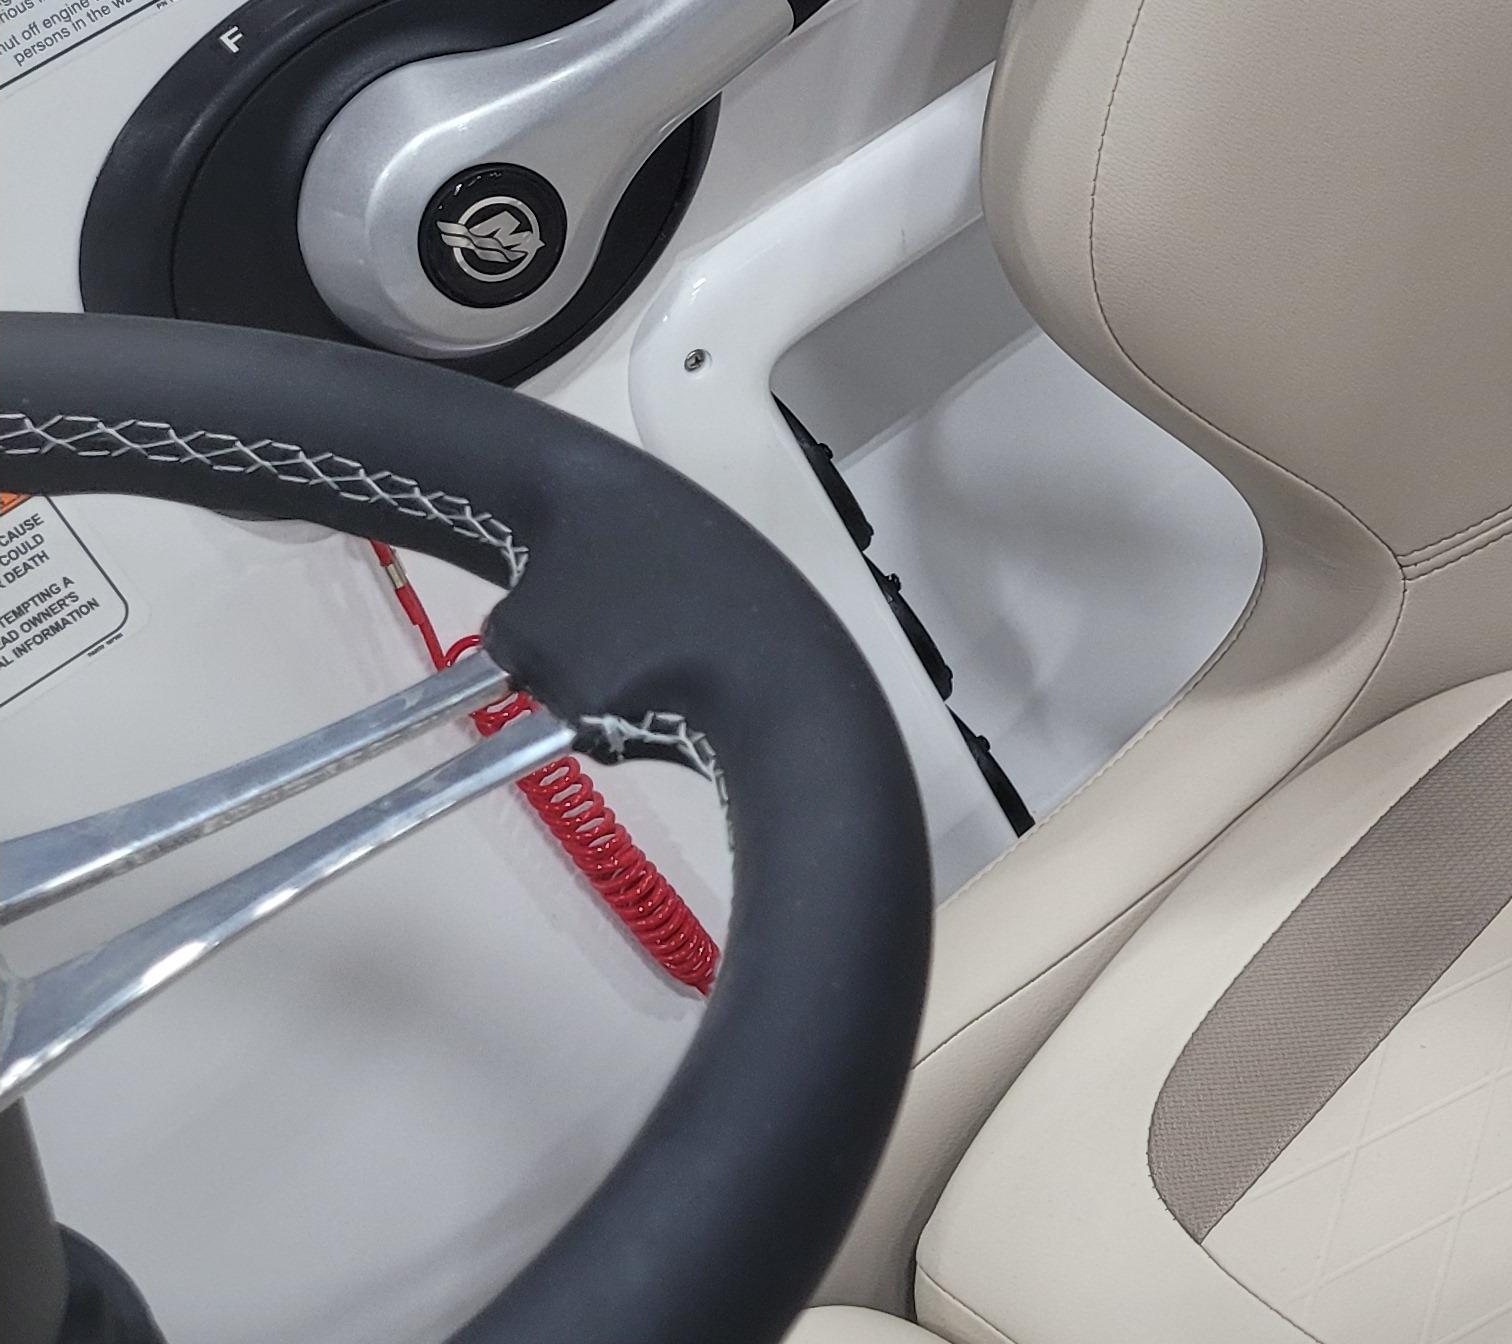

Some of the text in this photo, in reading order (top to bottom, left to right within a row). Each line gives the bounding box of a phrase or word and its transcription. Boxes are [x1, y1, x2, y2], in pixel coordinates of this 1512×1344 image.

[12, 27, 71, 68] persons
[71, 18, 87, 32] in
[86, 4, 112, 23] the
[21, 20, 41, 41] off
[220, 26, 243, 53] F
[0, 513, 44, 546] CAUSE
[0, 533, 44, 566] COULD
[3, 550, 50, 584] DEATH
[62, 576, 75, 589] A
[0, 591, 80, 651] AD OWNER'S
[12, 597, 100, 658] INFORMATION
